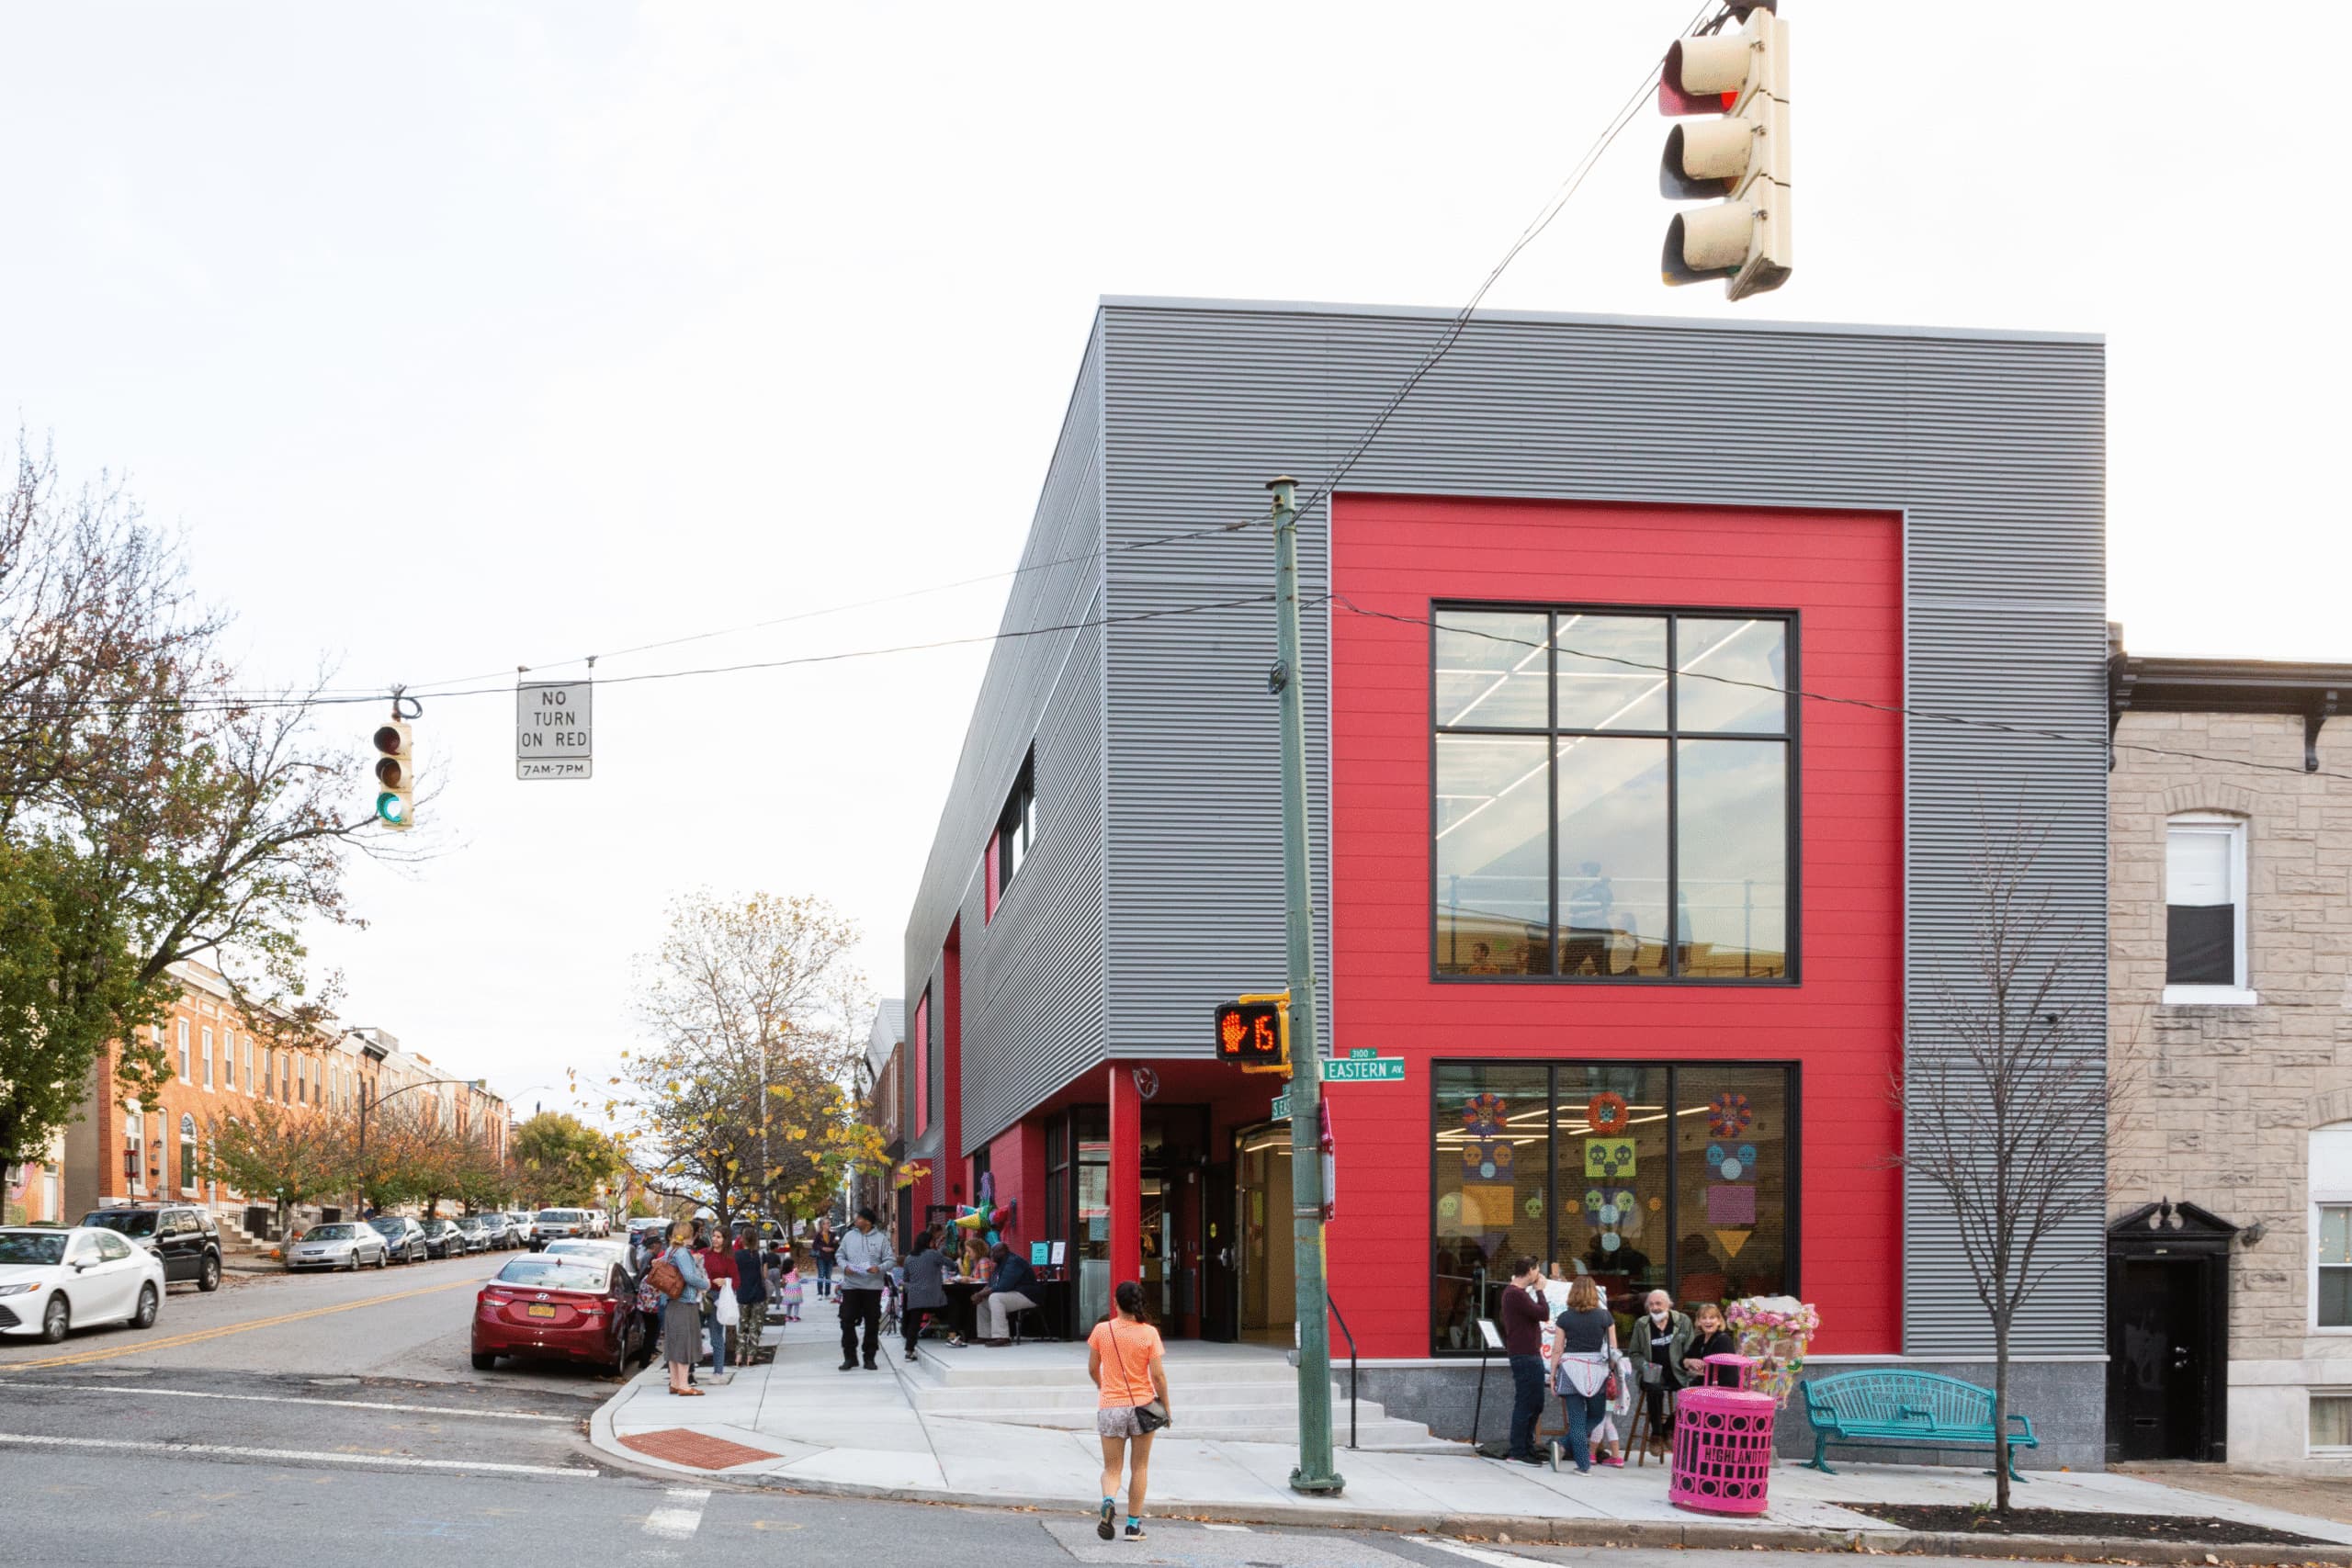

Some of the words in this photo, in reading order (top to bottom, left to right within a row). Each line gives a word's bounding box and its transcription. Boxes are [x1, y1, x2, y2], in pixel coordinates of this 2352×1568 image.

[542, 691, 567, 705] NO
[534, 711, 575, 726] TURN
[522, 733, 543, 747] ON
[556, 732, 587, 746] RED
[523, 764, 584, 776] 7AM-7PM
[1255, 1015, 1273, 1050] 15
[1351, 1049, 1369, 1058] 3100
[1329, 1062, 1387, 1078] EASTERN
